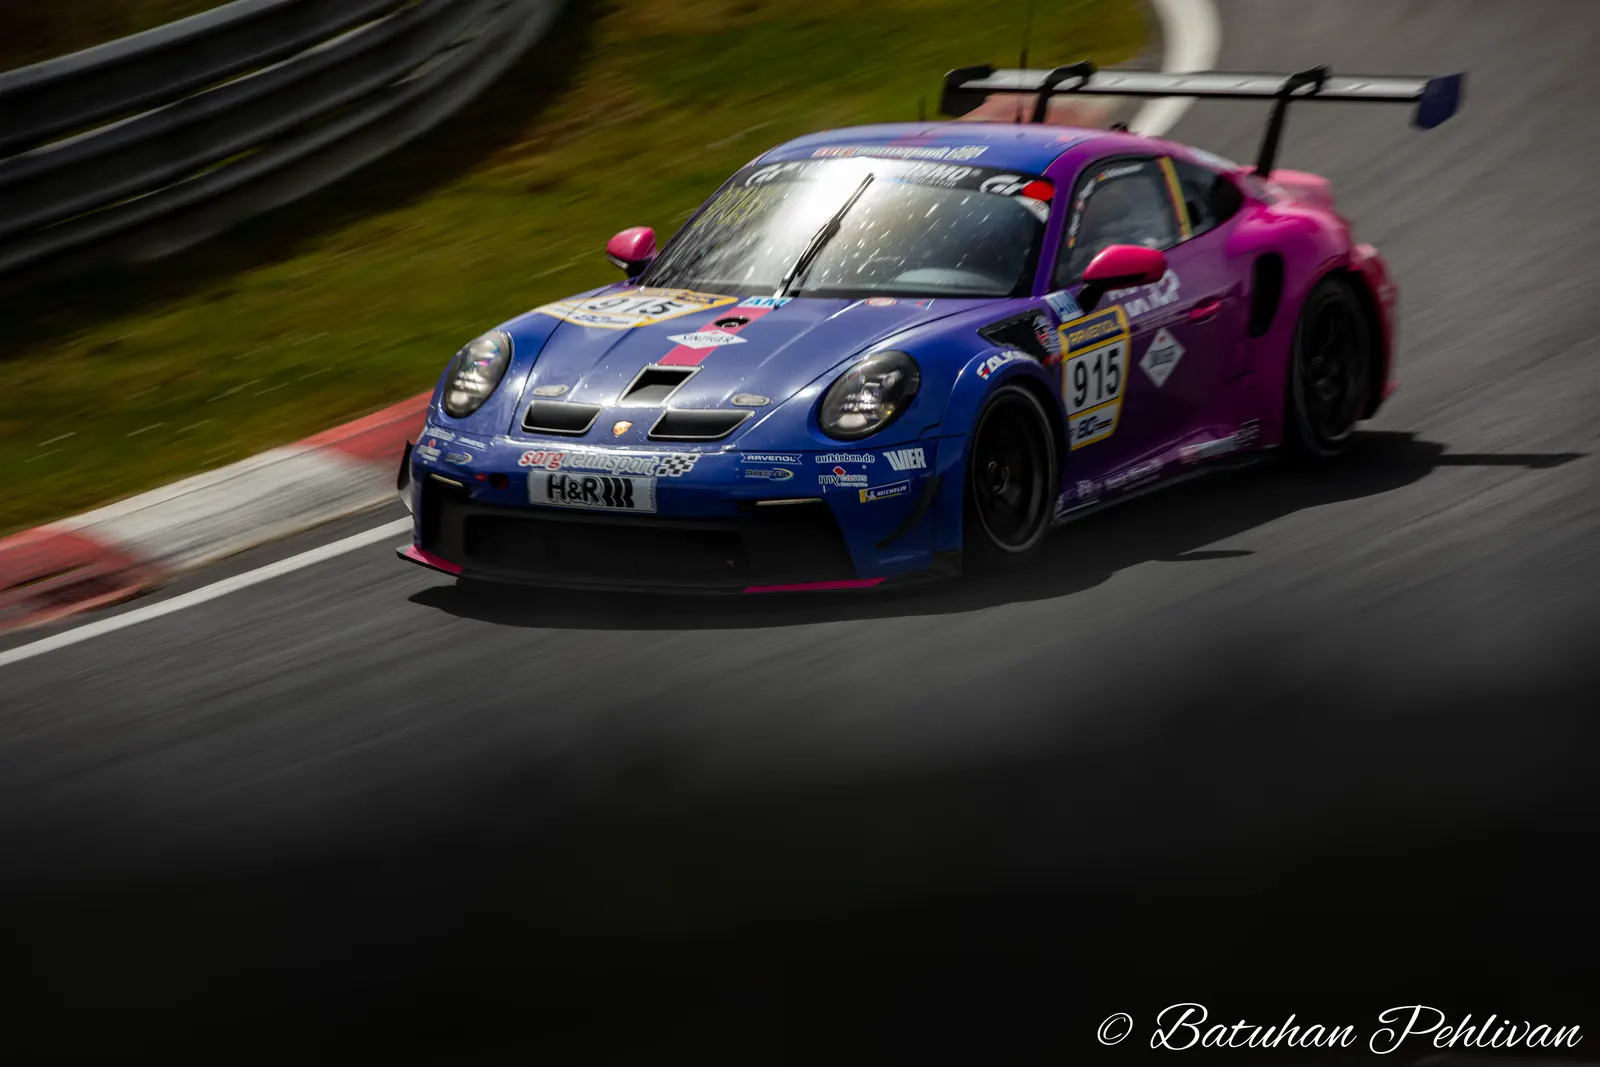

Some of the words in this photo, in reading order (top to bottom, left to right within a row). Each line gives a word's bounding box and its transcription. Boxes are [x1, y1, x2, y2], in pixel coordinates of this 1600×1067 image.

[588, 298, 684, 315] 915
[1074, 347, 1119, 408] 915
[747, 454, 797, 463] RAVENOL
[815, 453, 875, 463] aufkleben.de
[547, 474, 600, 503] H&R
[876, 484, 907, 497] MICHELIN
